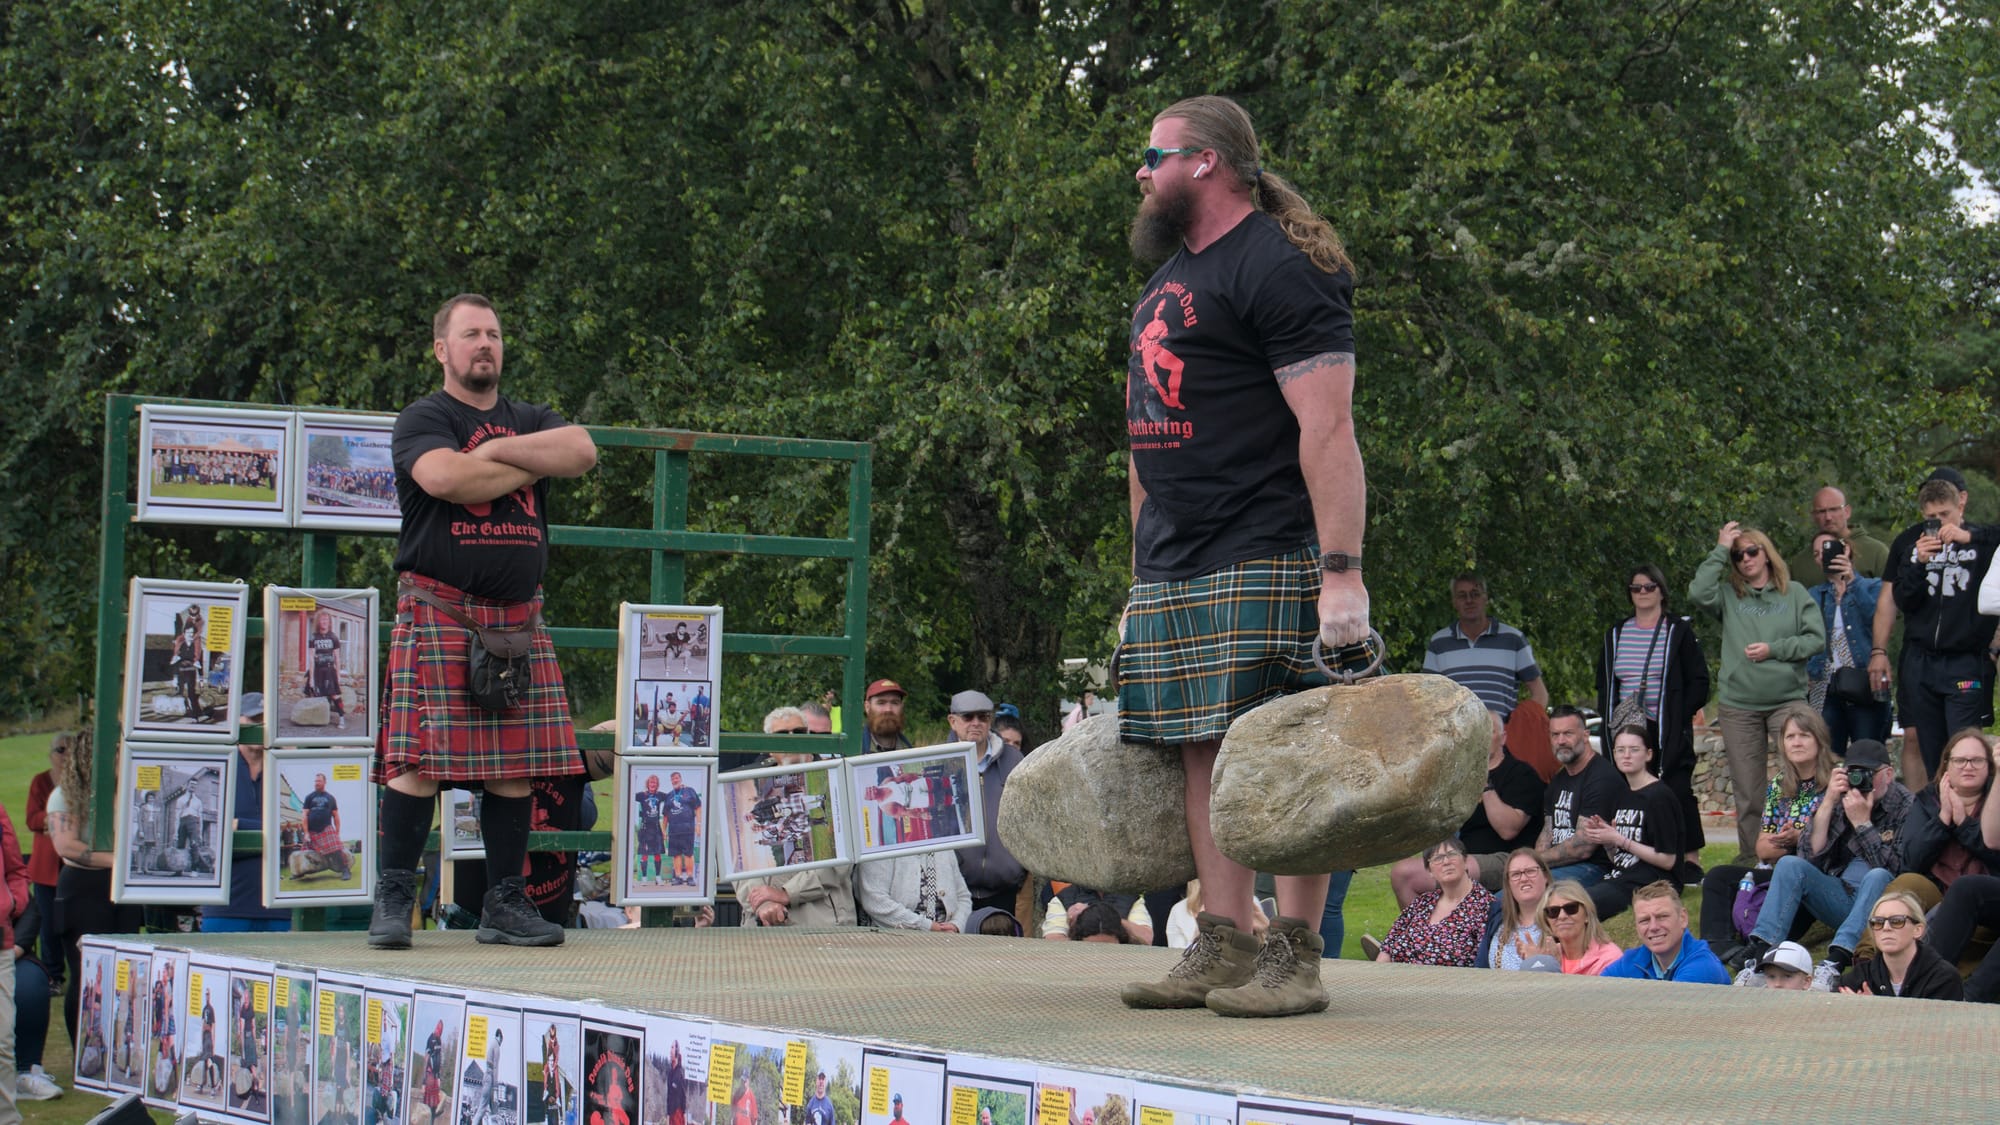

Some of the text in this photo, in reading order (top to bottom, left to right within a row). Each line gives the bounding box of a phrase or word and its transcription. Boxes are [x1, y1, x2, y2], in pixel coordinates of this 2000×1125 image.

[1180, 292, 1197, 328] Day
[451, 522, 542, 541] The Gathering
[625, 1067, 634, 1092] Day
